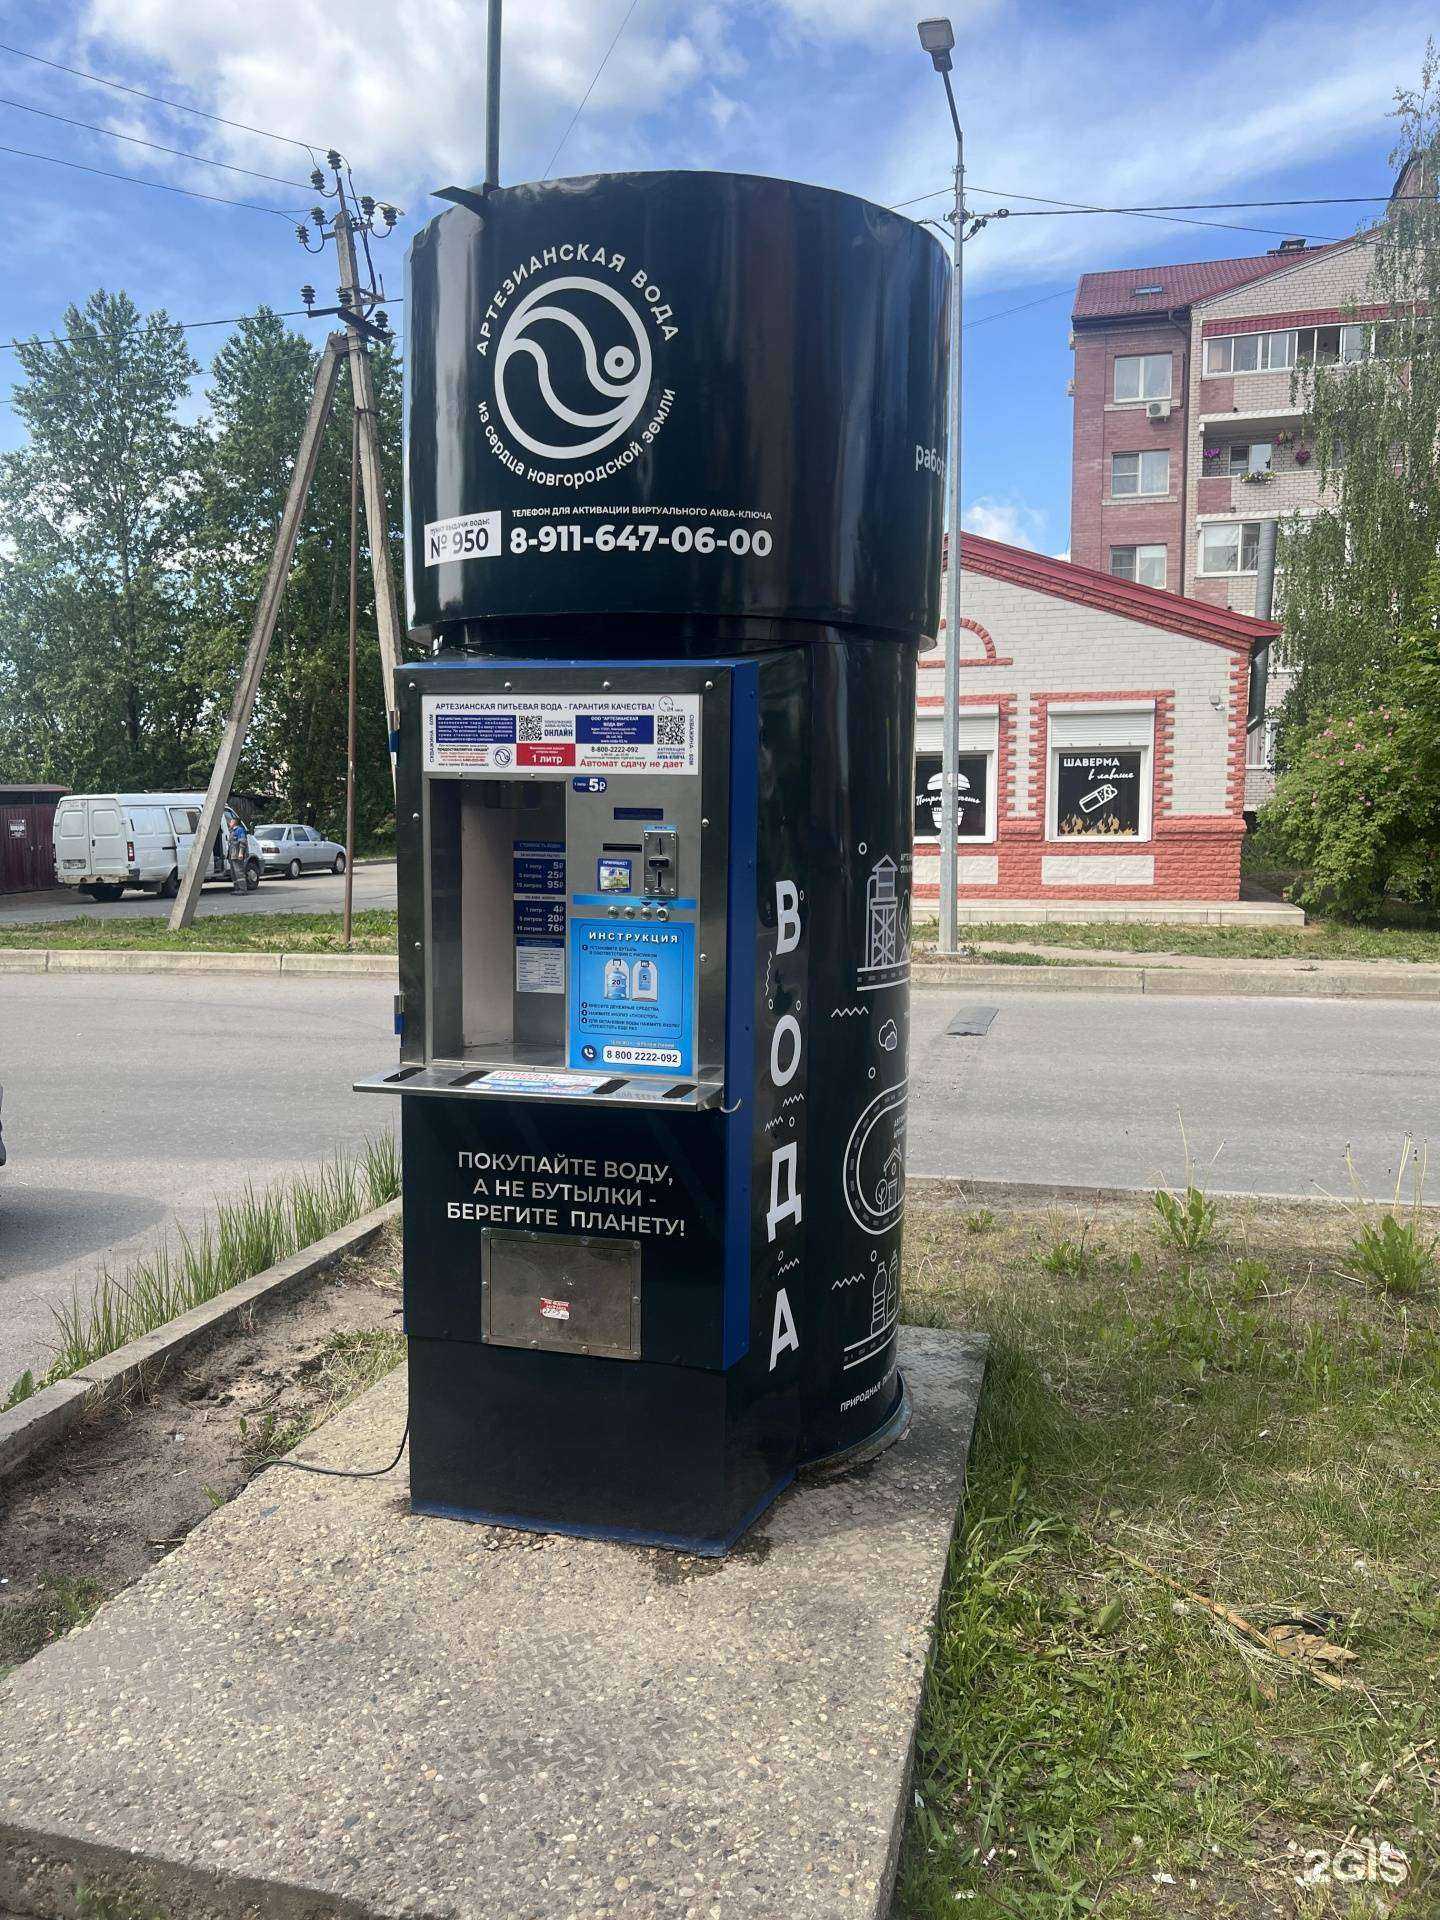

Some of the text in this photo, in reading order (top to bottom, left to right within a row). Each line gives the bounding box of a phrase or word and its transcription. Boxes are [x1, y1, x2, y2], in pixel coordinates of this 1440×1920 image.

[476, 243, 679, 356] АРТЕЗИАНСКАЯ ВОДА
[477, 388, 676, 490] из сердца новгородской земли
[512, 506, 773, 520] ТЕЛЕФОН ДЛЯ АКТИВАЦИИ ВИРТУАЛЬНОГО АКВА-КЛЮЧА
[452, 527, 489, 555] 950
[510, 524, 773, 557] 8-911-647-06-00
[436, 703, 496, 711] АРТЕЗИАНСКАЯ
[497, 703, 539, 711] ПИТЬЕВАЯ
[540, 703, 563, 711] ВОДА
[568, 703, 610, 711] ГАРАНТИЯ
[611, 703, 655, 711] КАЧЕСТВА!
[544, 728, 573, 737] ОНЛАЙН
[532, 754, 563, 765] 1 литр
[580, 759, 619, 768] Автомат
[620, 761, 647, 769] сдачу
[1063, 757, 1120, 767] ШАВЕРМА
[1088, 768, 1135, 780] в лаваше
[588, 932, 679, 944] ИНСТРУКЦИЯ
[606, 1050, 678, 1063] 8 800 2222-092
[458, 1151, 674, 1186] ПОКУПАЙТЕ ВОДУ,
[473, 1178, 489, 1196] А
[495, 1178, 525, 1198] НЕ
[531, 1181, 642, 1207] БУТЫЛКИ
[447, 1202, 686, 1237] БЕРЕГИТЕ ПЛАНЕТУ!
